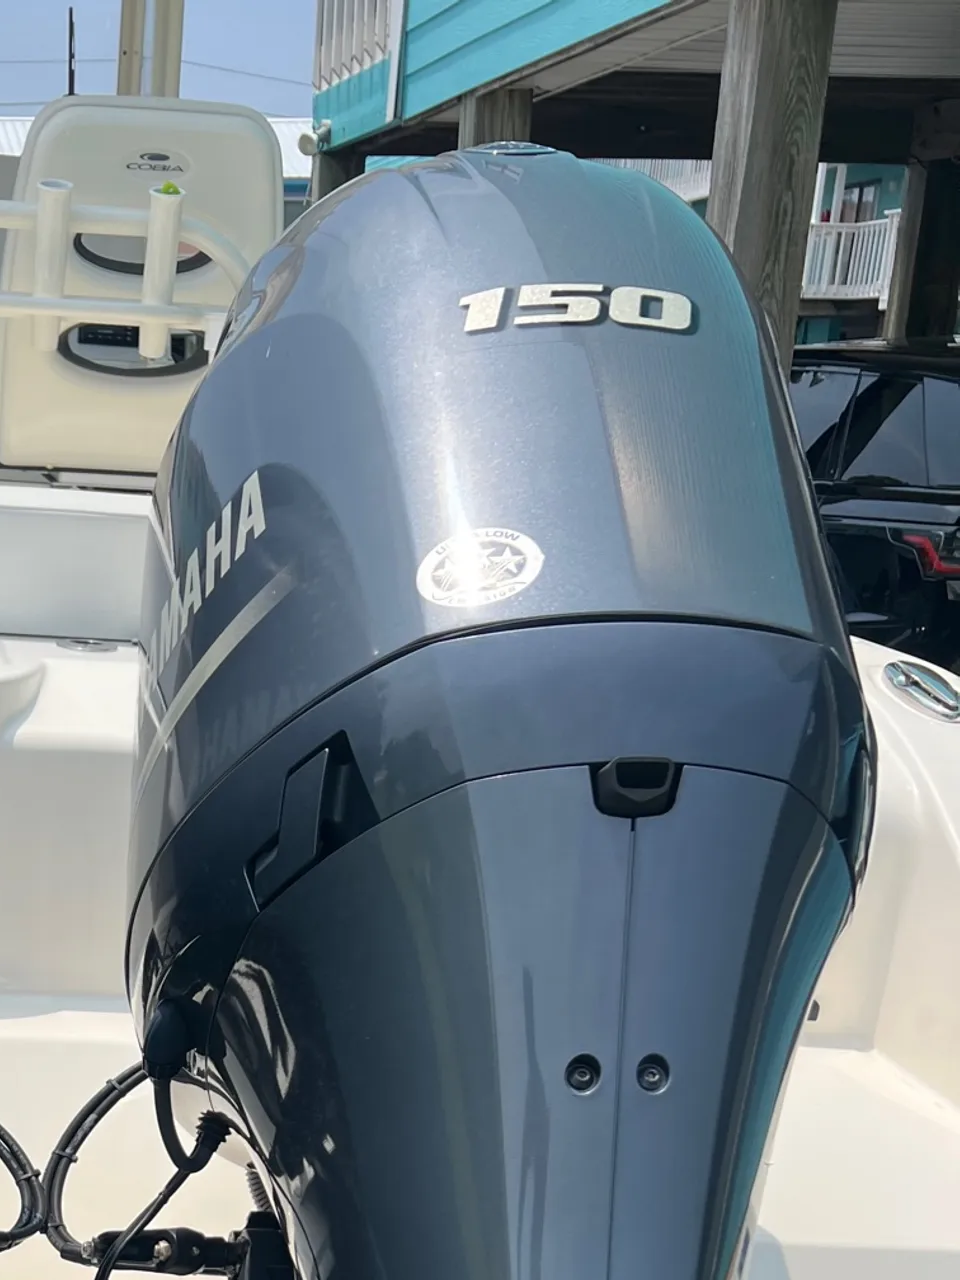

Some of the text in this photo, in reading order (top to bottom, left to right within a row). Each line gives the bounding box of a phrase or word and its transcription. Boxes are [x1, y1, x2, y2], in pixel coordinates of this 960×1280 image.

[126, 162, 184, 173] COBIA
[458, 283, 692, 333] 150
[146, 469, 266, 695] AMAHA
